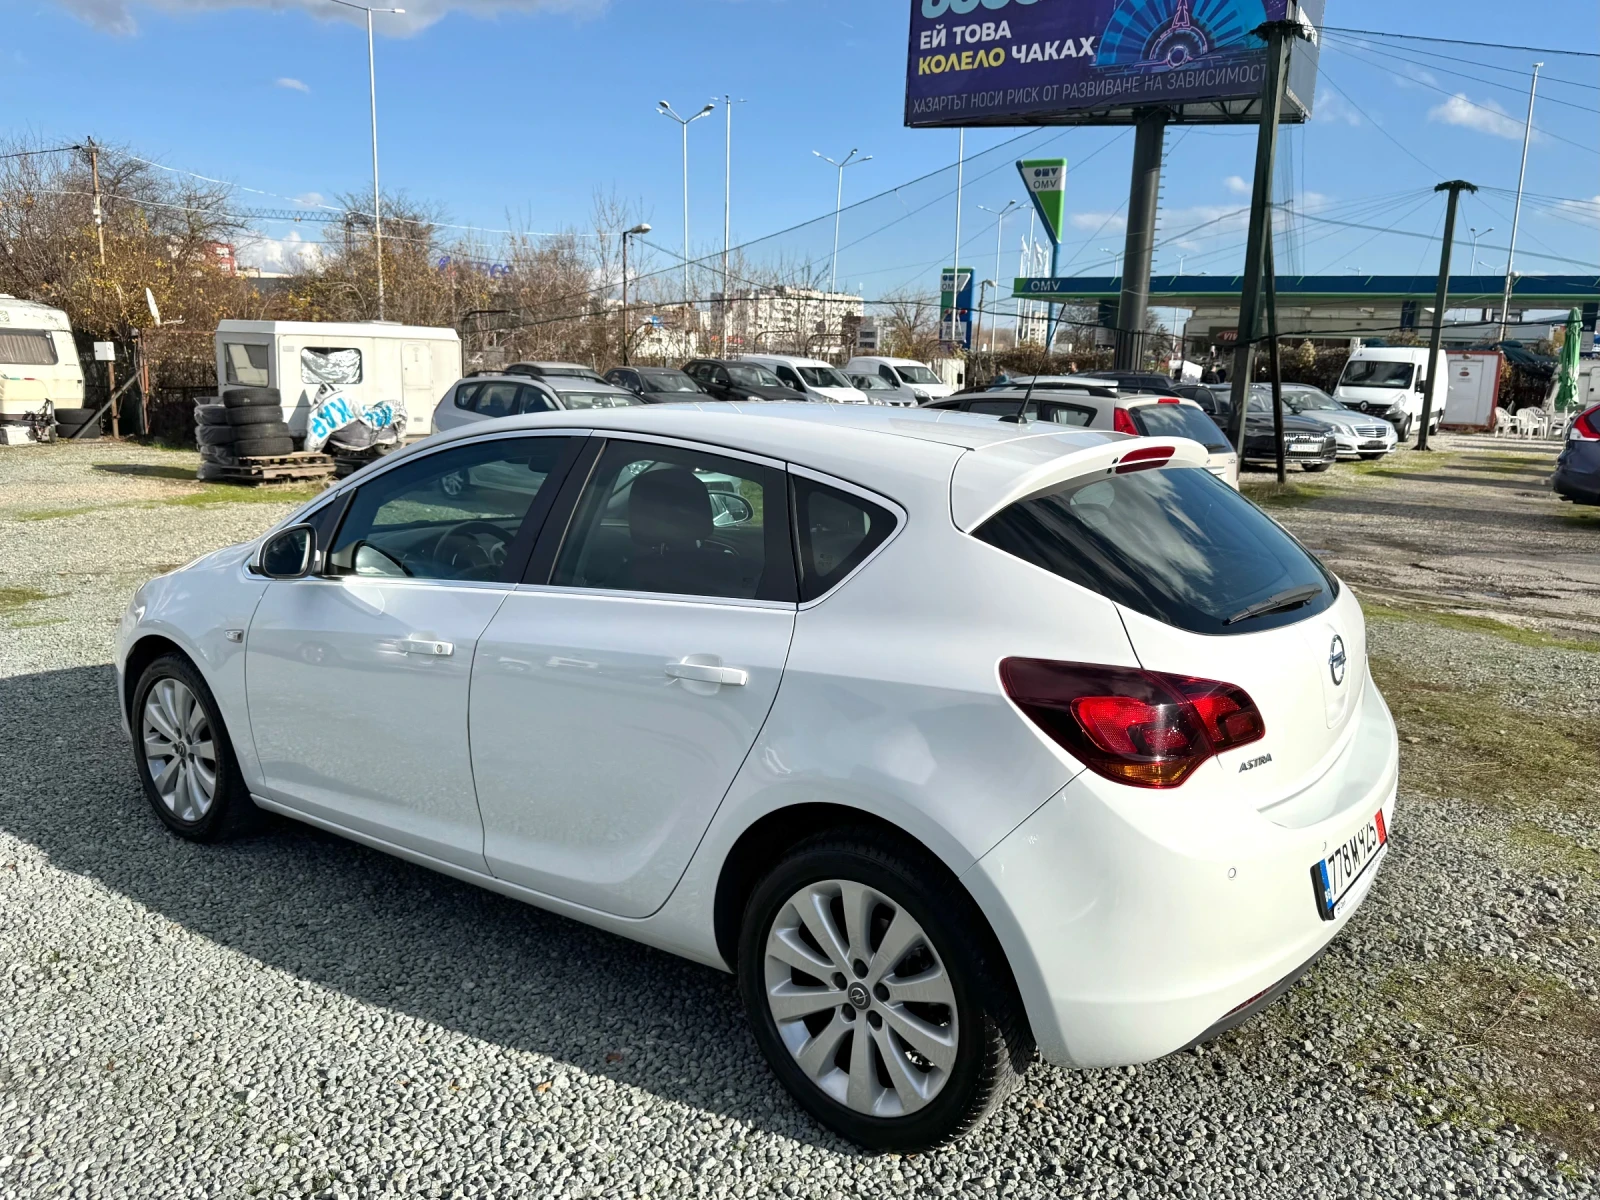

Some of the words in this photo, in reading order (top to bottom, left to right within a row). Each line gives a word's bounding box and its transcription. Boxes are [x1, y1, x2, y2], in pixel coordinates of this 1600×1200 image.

[920, 24, 947, 50] ЕЙ
[952, 20, 1012, 46] ТОВА
[918, 47, 1006, 76] КОЛЕЛО
[1011, 36, 1096, 64] ЧАКАХ
[913, 93, 968, 114] ХАЗАРТЪТ
[971, 90, 1004, 108] НОСИ
[1006, 86, 1040, 105] РИСК
[1043, 85, 1059, 100] ОТ
[1062, 76, 1140, 98] РАЗВИВАНЕ
[1144, 76, 1163, 91] НА
[1166, 63, 1267, 90] ЗАВИСИМОСТ
[1034, 167, 1058, 177] OMV
[1033, 179, 1057, 189] OMV
[1031, 280, 1061, 291] OMV
[1239, 753, 1272, 773] ASTRA
